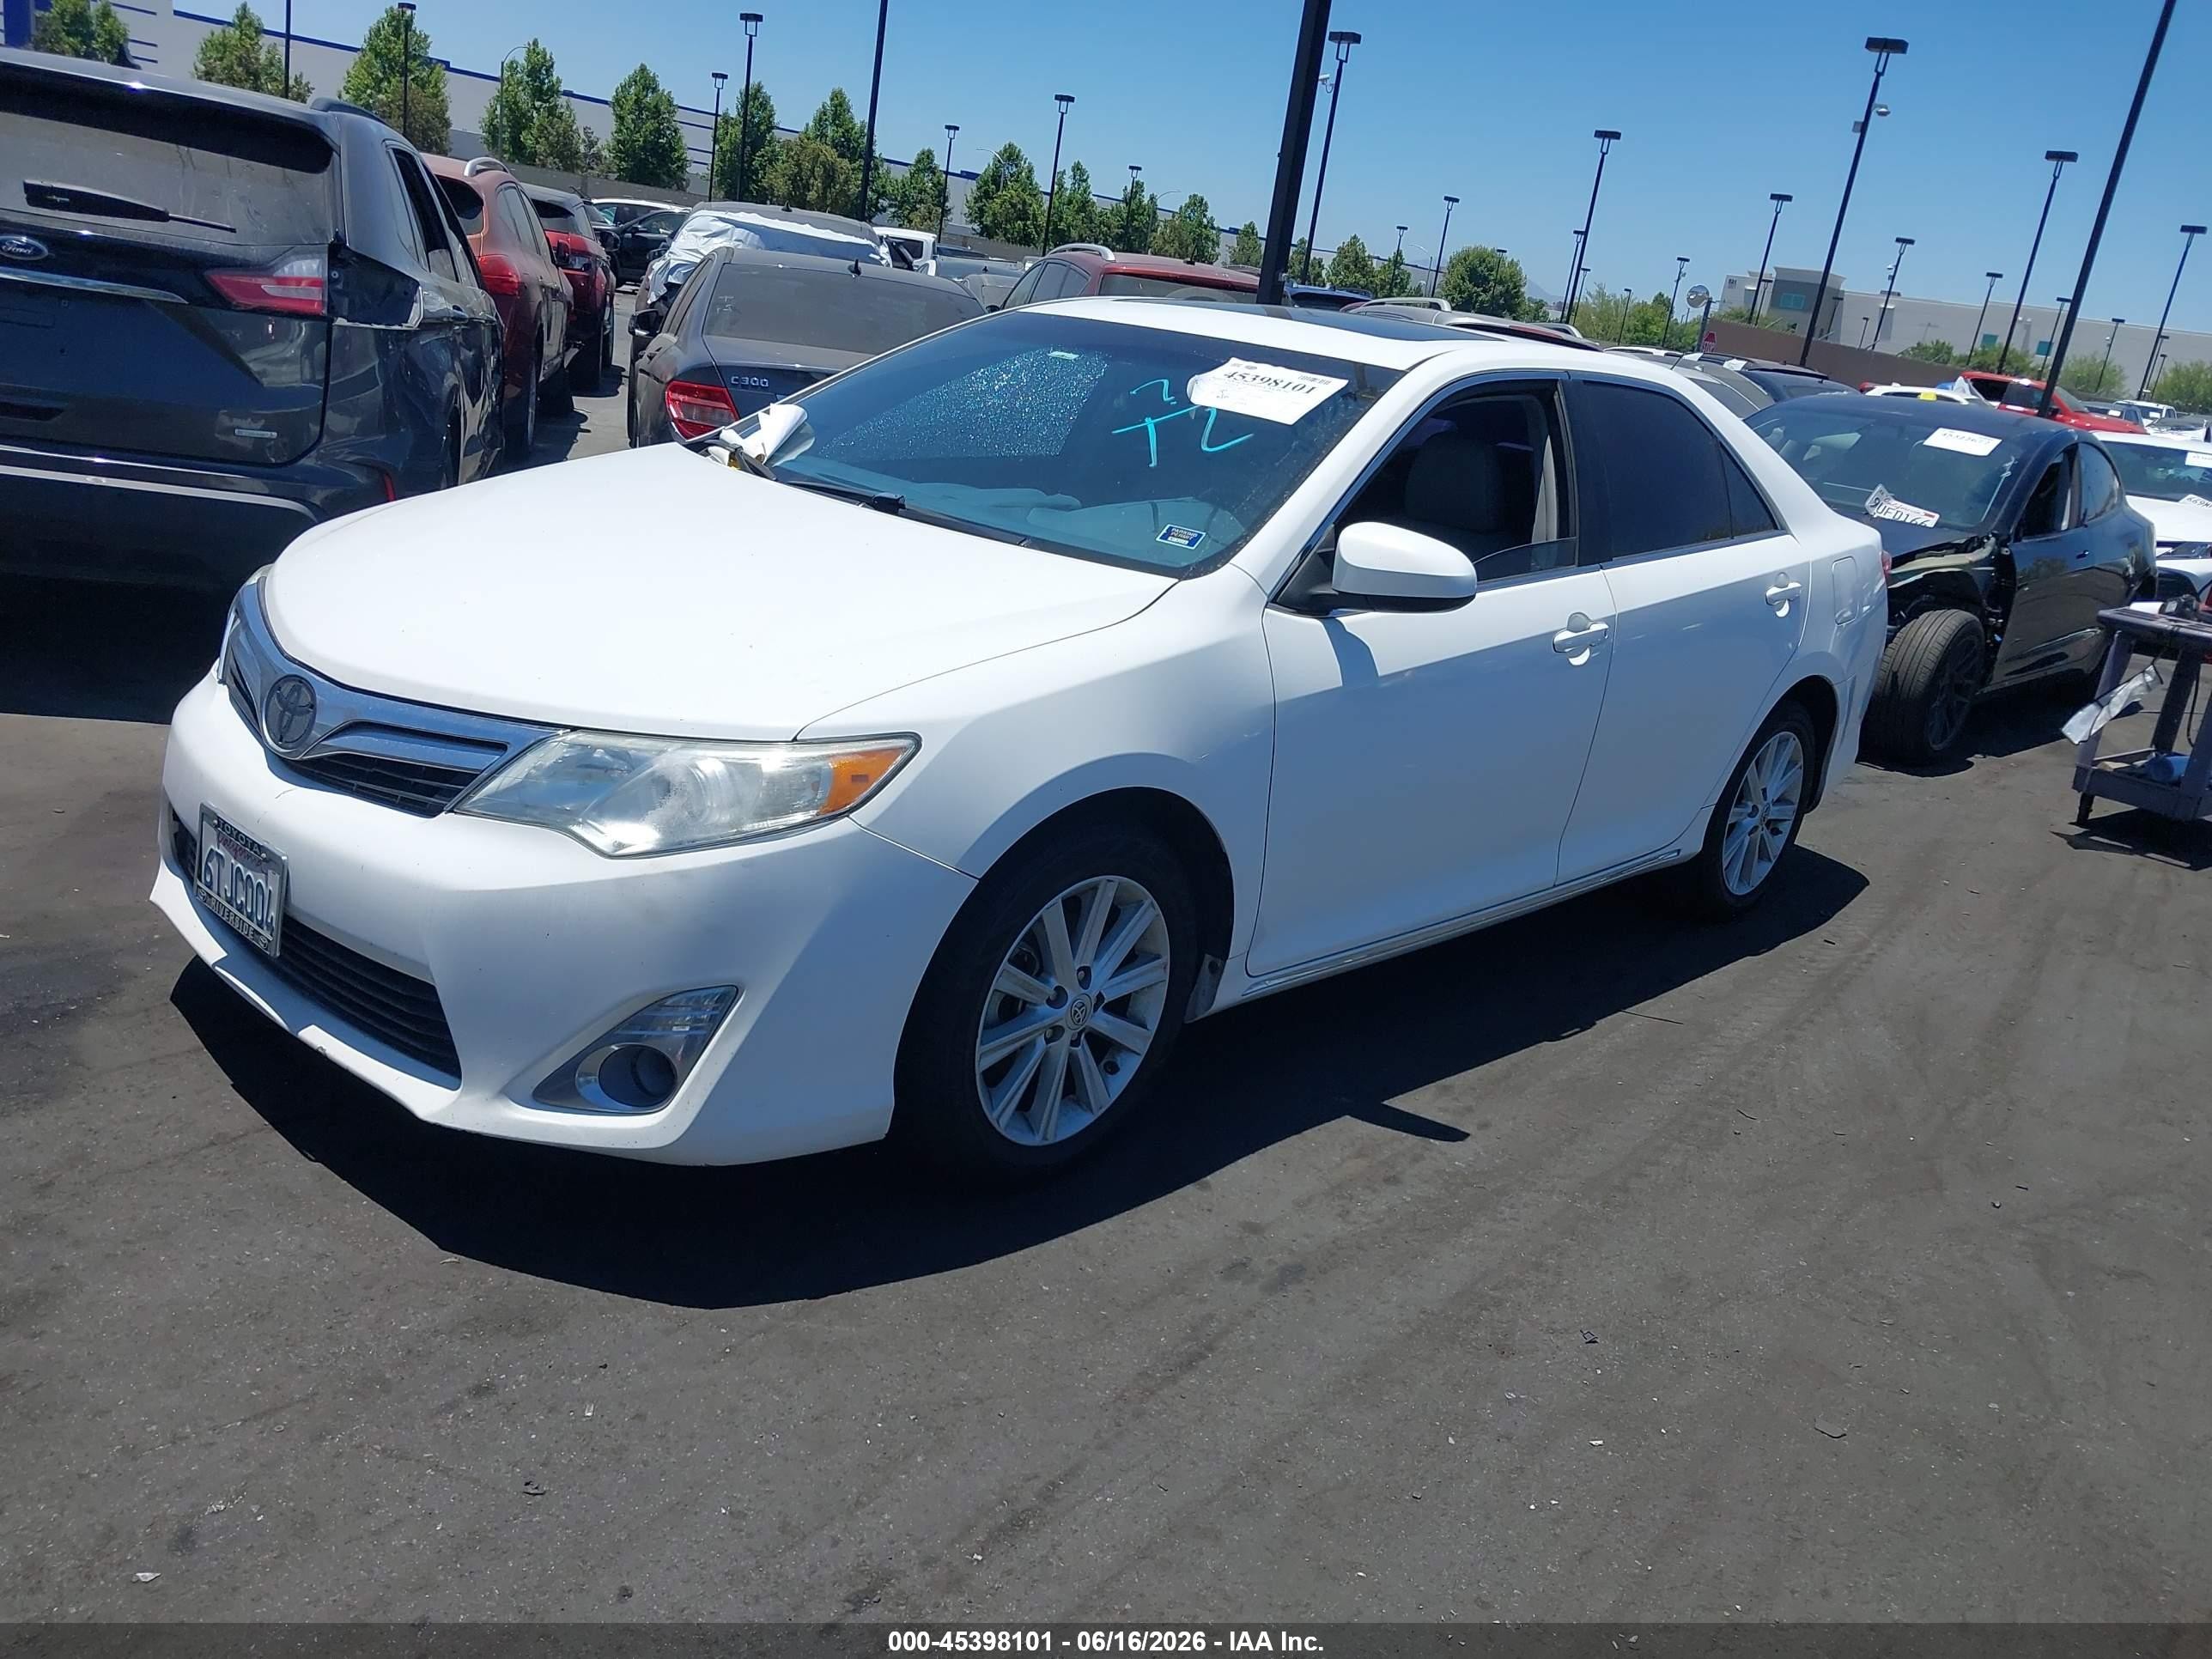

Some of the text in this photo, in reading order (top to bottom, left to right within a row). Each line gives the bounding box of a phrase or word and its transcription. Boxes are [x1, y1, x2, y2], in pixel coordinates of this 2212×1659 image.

[2, 240, 33, 255] Ford
[731, 376, 769, 387] C300
[1224, 371, 1320, 395] 45398101
[218, 819, 262, 854] TOYOTA
[211, 897, 256, 940] RIVERSIDE
